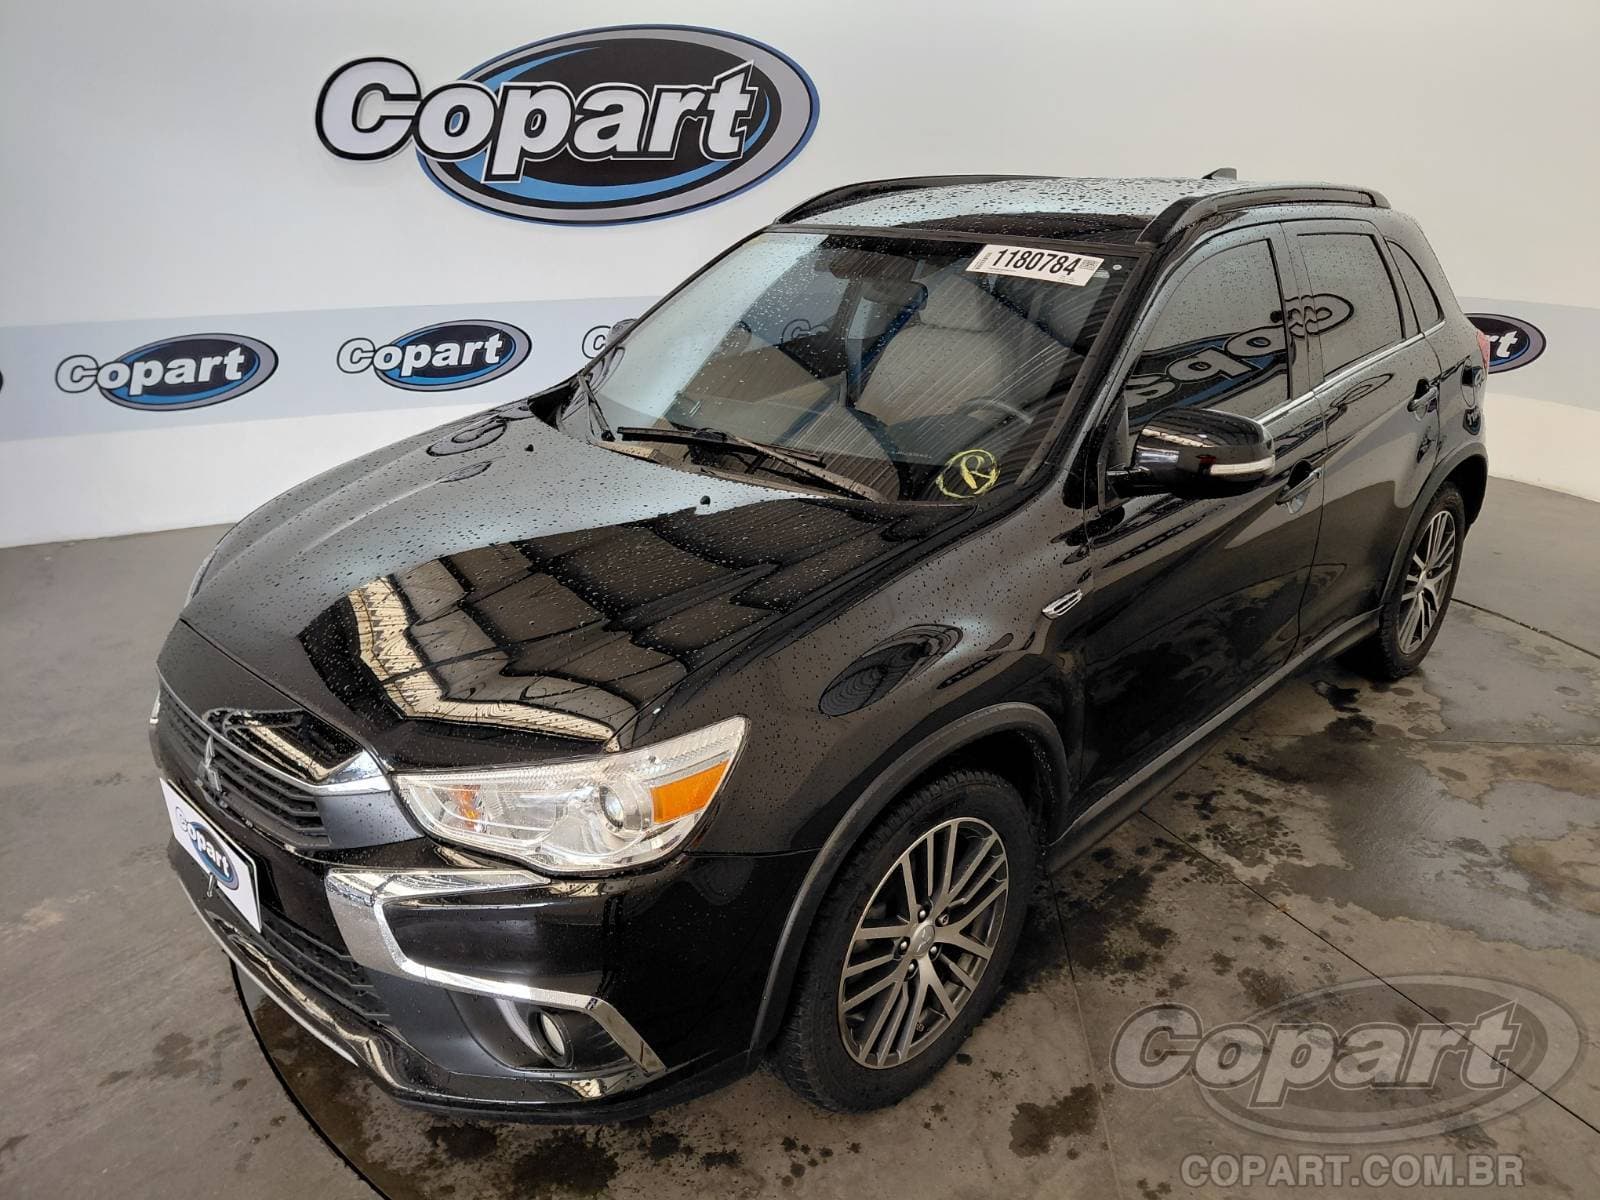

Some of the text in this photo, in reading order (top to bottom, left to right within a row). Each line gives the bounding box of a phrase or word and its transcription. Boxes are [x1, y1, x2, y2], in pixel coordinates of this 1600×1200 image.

[316, 57, 758, 183] Copart
[992, 249, 1082, 276] 1180784
[56, 347, 245, 396] Copart
[337, 333, 503, 377] Copart
[176, 806, 230, 878] Copart
